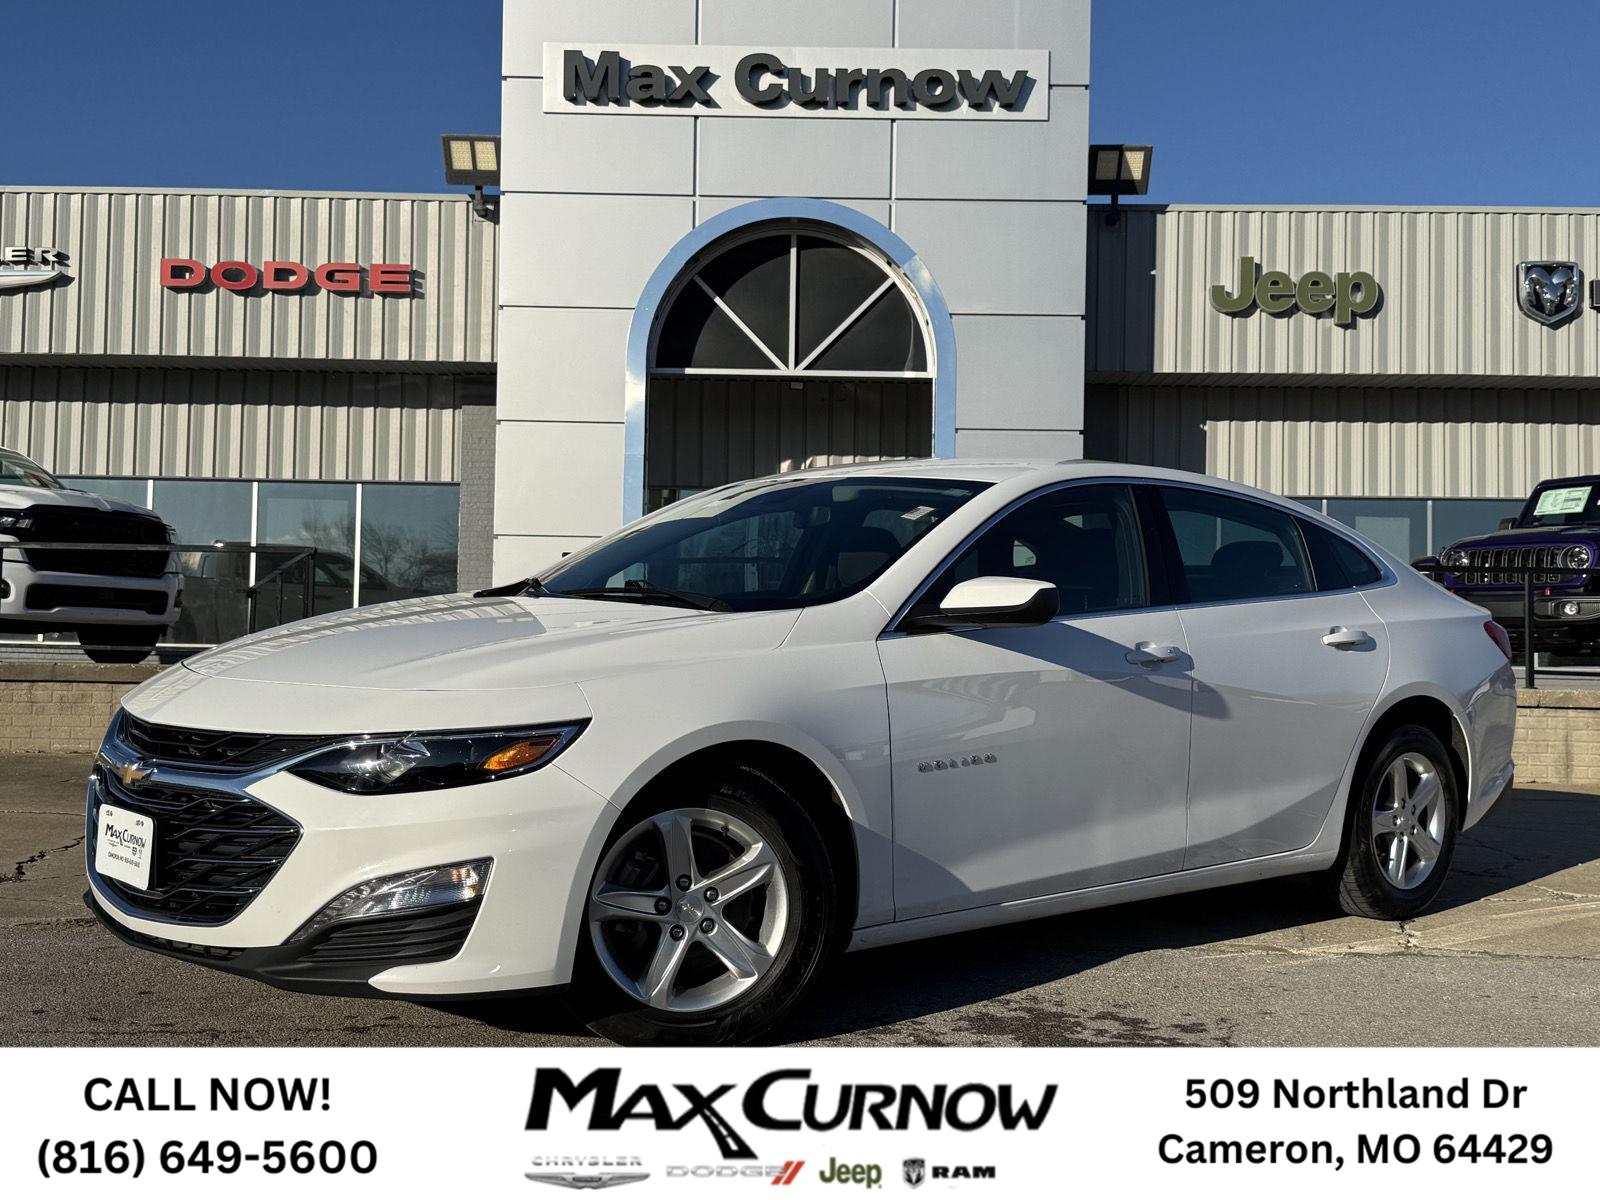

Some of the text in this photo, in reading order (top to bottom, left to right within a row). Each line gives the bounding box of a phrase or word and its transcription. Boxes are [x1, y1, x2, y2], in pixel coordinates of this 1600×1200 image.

[562, 50, 1030, 110] Max Curnow
[160, 258, 414, 294] DODGE
[1210, 256, 1380, 327] Jeep
